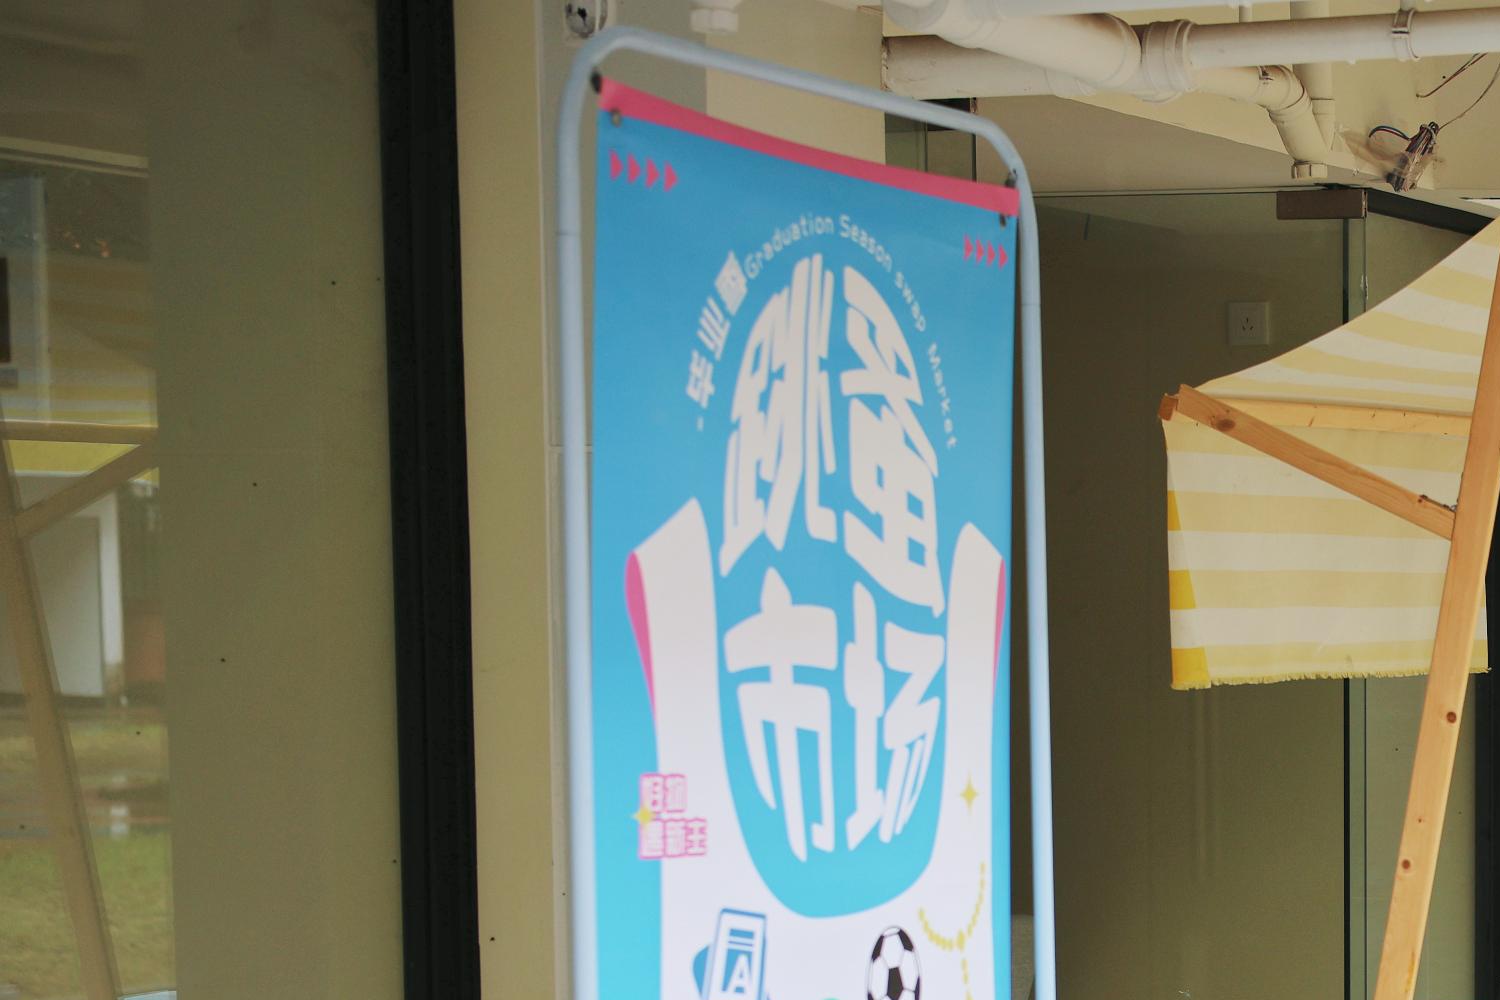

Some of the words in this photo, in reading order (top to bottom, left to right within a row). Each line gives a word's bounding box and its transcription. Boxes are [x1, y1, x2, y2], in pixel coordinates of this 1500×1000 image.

[719, 252, 945, 618] 跳蚤
[744, 214, 834, 279] Graduation
[839, 213, 892, 272] Season
[928, 342, 957, 449] Market
[723, 566, 946, 862] 市场
